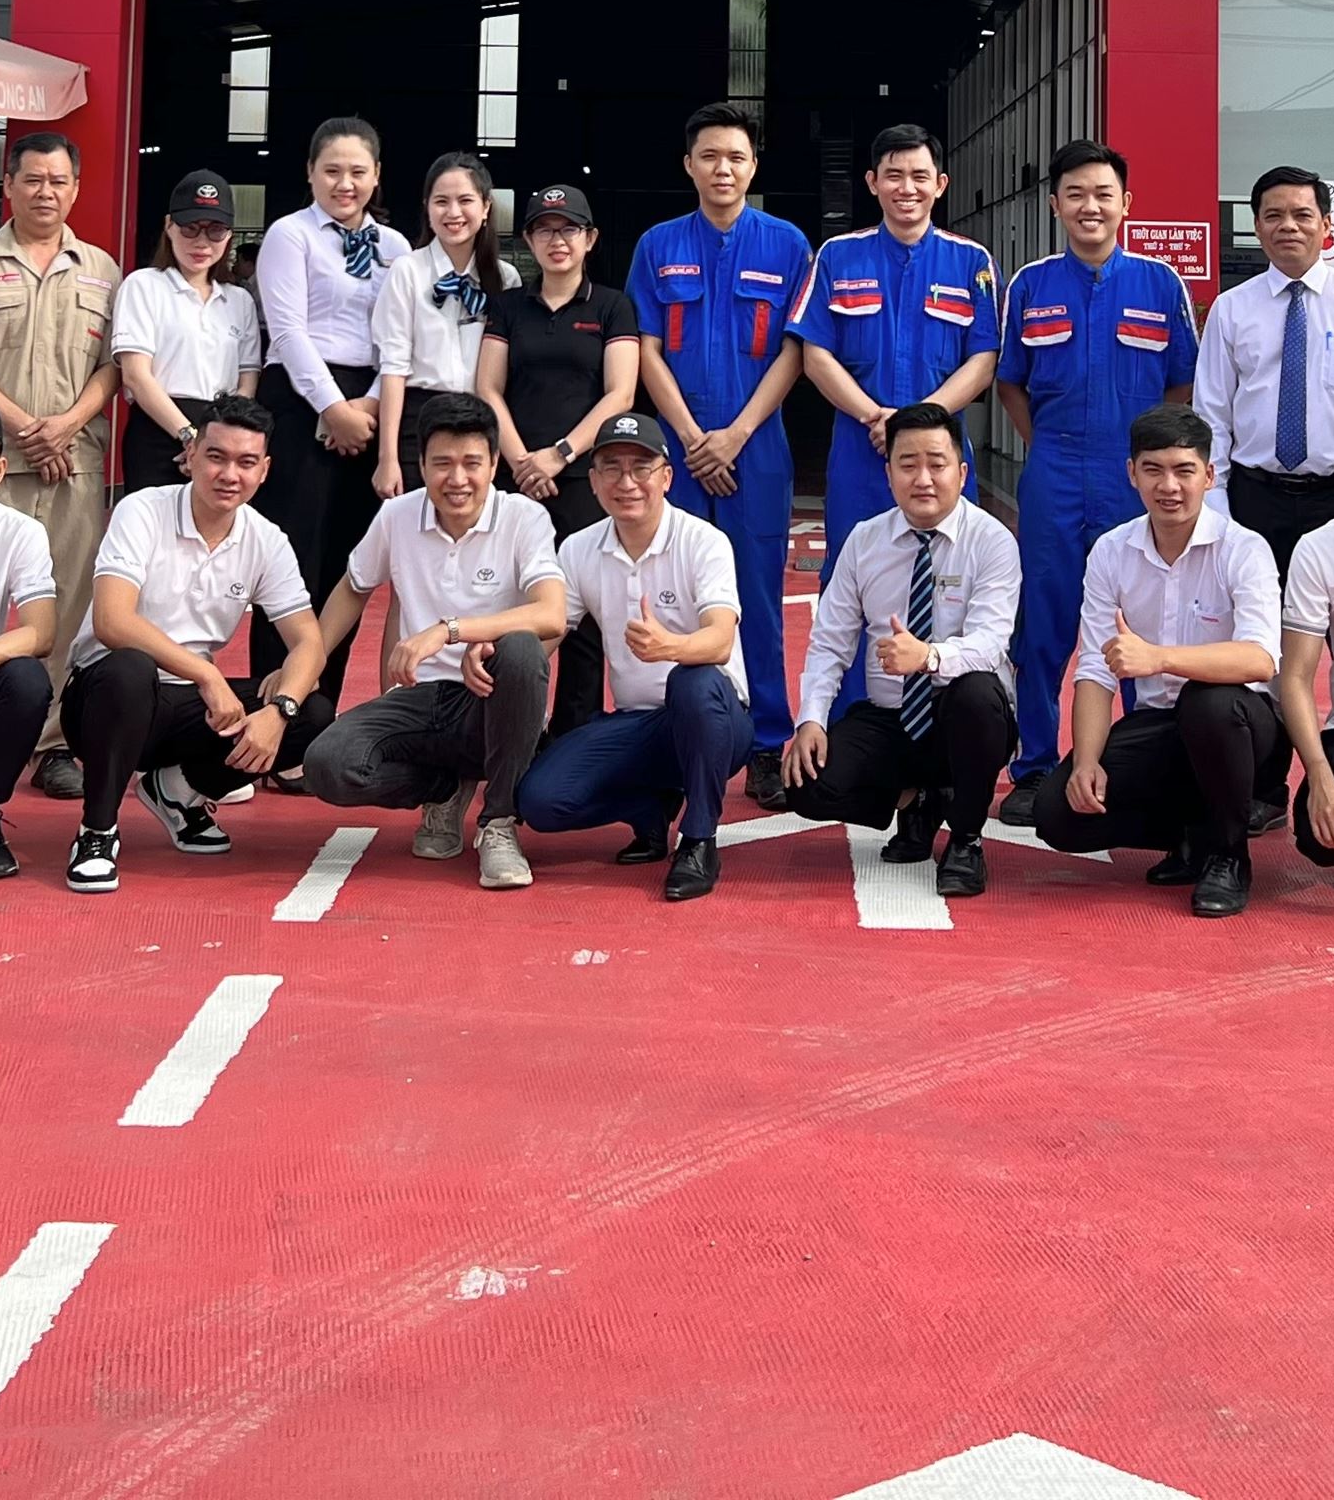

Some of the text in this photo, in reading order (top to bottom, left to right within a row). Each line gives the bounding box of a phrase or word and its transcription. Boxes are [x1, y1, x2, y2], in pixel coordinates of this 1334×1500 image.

[28, 84, 47, 112] AN
[1131, 227, 1203, 242] THỜI GIAN LÀM VIỆC
